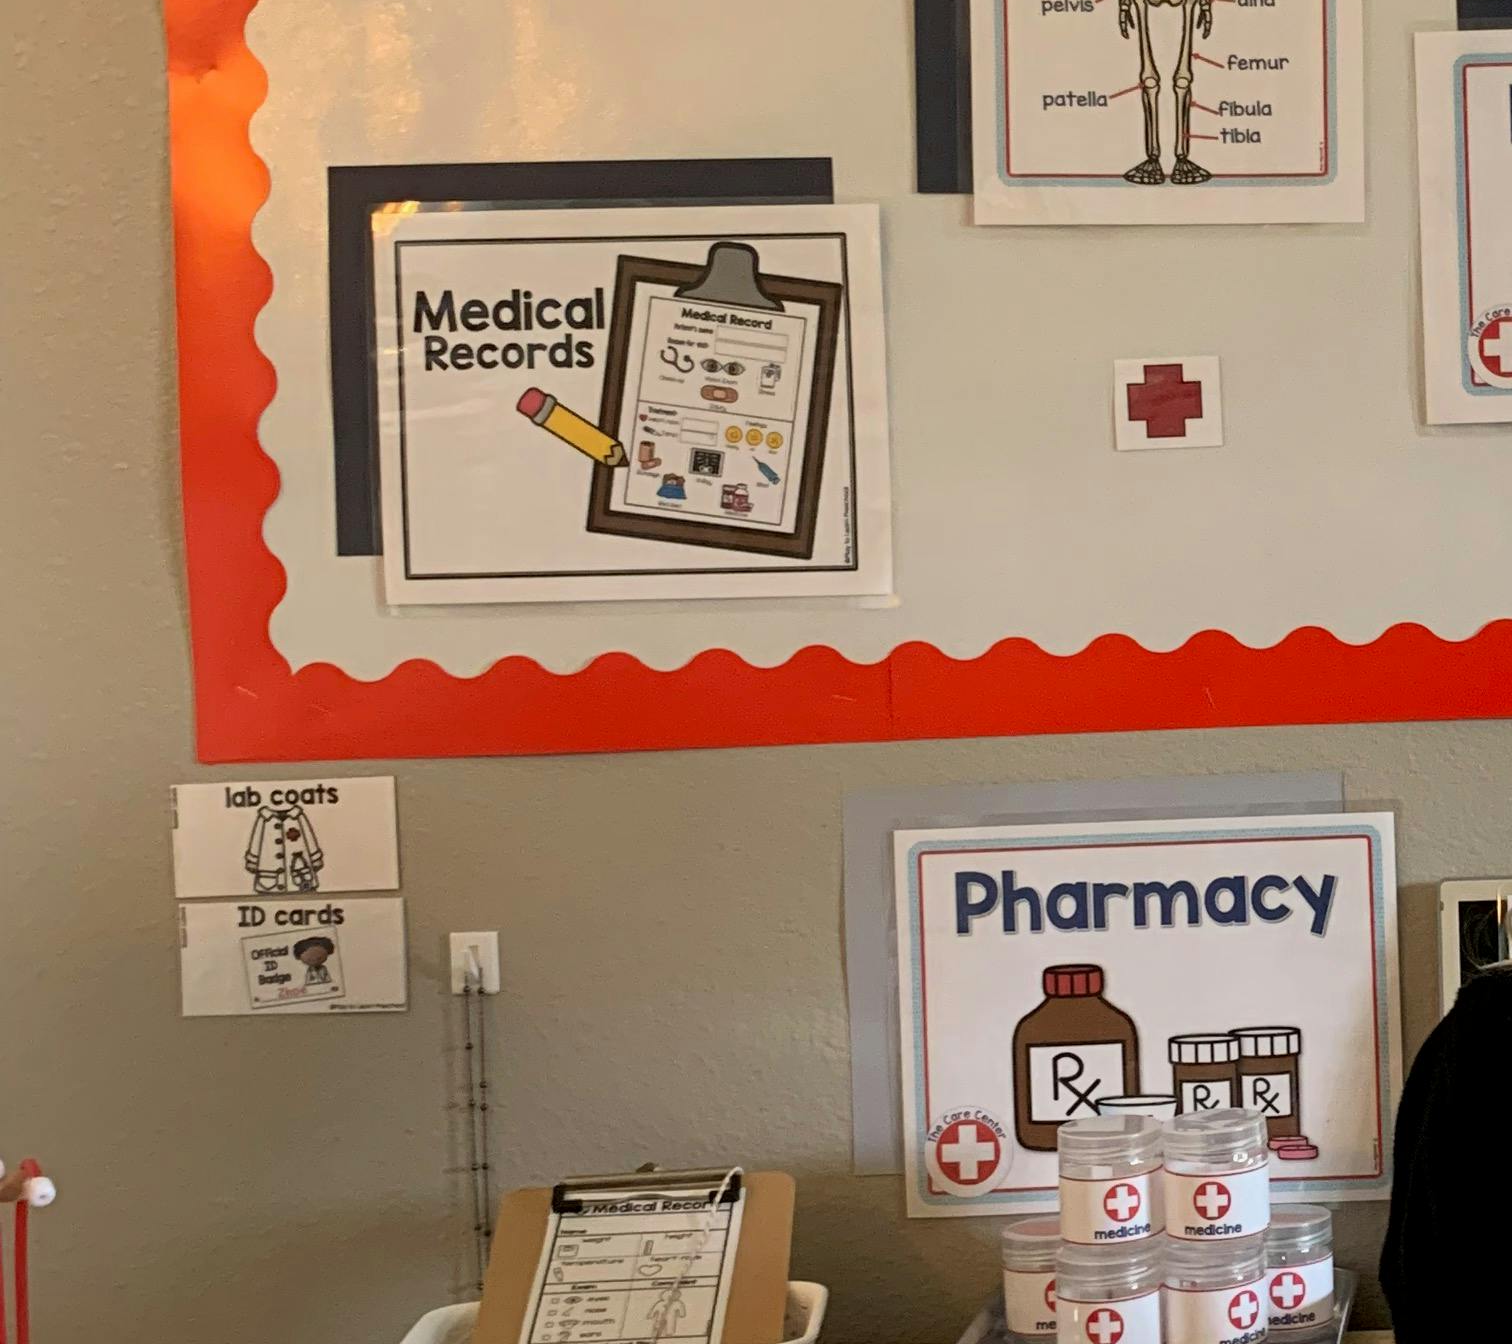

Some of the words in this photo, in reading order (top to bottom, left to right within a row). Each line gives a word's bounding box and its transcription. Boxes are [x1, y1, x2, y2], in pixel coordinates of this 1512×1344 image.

[1226, 54, 1290, 71] femur
[1042, 90, 1108, 111] patella
[1218, 99, 1272, 117] fibula
[1219, 127, 1262, 144] tibia
[413, 287, 605, 333] Medical
[681, 307, 727, 324] Medical
[729, 313, 773, 330] Record
[1485, 307, 1511, 322] Care
[424, 334, 595, 372] Records
[226, 786, 262, 808] lab
[270, 785, 339, 805] coats
[955, 869, 1339, 937] Pharmacy
[238, 905, 266, 927] ID
[274, 904, 344, 925] cards
[943, 1110, 971, 1125] Care
[975, 1110, 1006, 1139] Center
[593, 1201, 656, 1214] Medical
[662, 1201, 712, 1211] Recor
[1094, 1223, 1151, 1240] medicine
[1184, 1222, 1242, 1235] medicine
